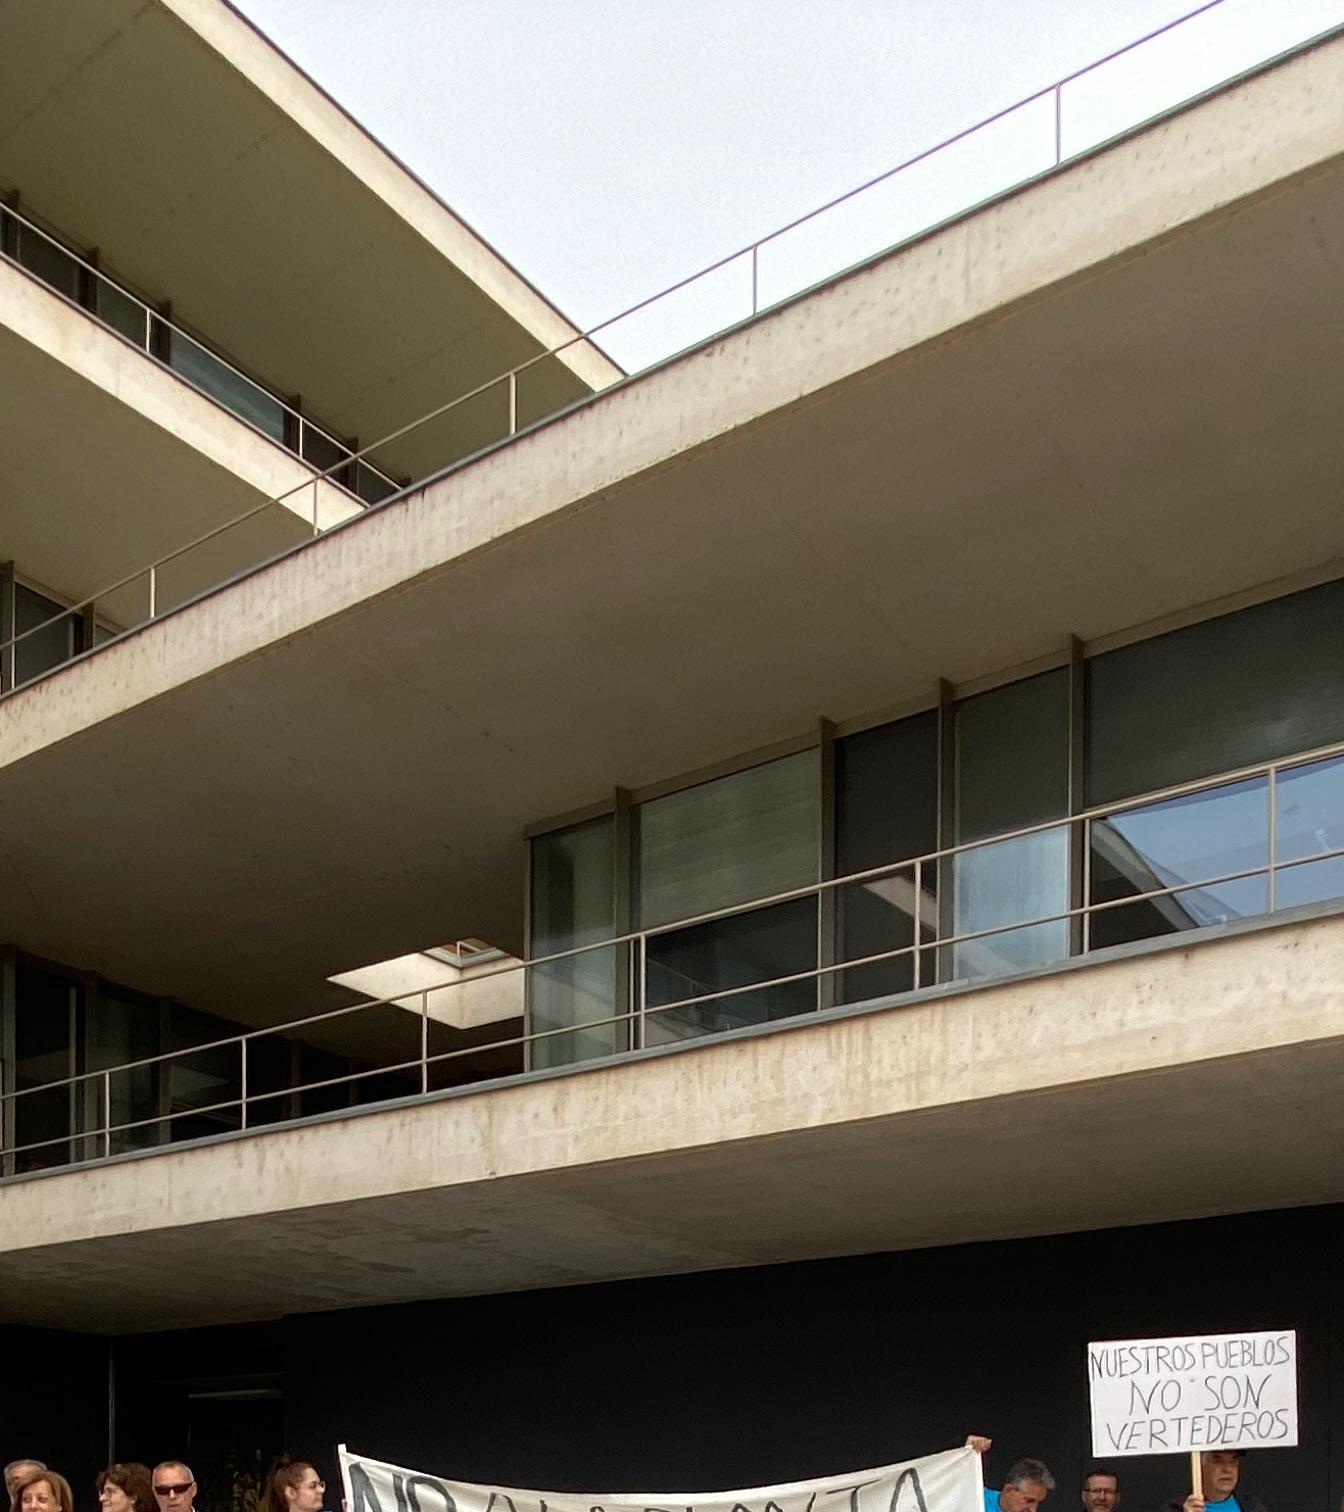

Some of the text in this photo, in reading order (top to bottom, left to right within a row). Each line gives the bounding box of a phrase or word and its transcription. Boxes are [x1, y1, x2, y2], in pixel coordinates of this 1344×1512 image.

[1091, 1336, 1290, 1381] NUESTROS PUEBLOS
[1129, 1374, 1272, 1416] NO SON
[1106, 1408, 1289, 1450] VERTEDEROS
